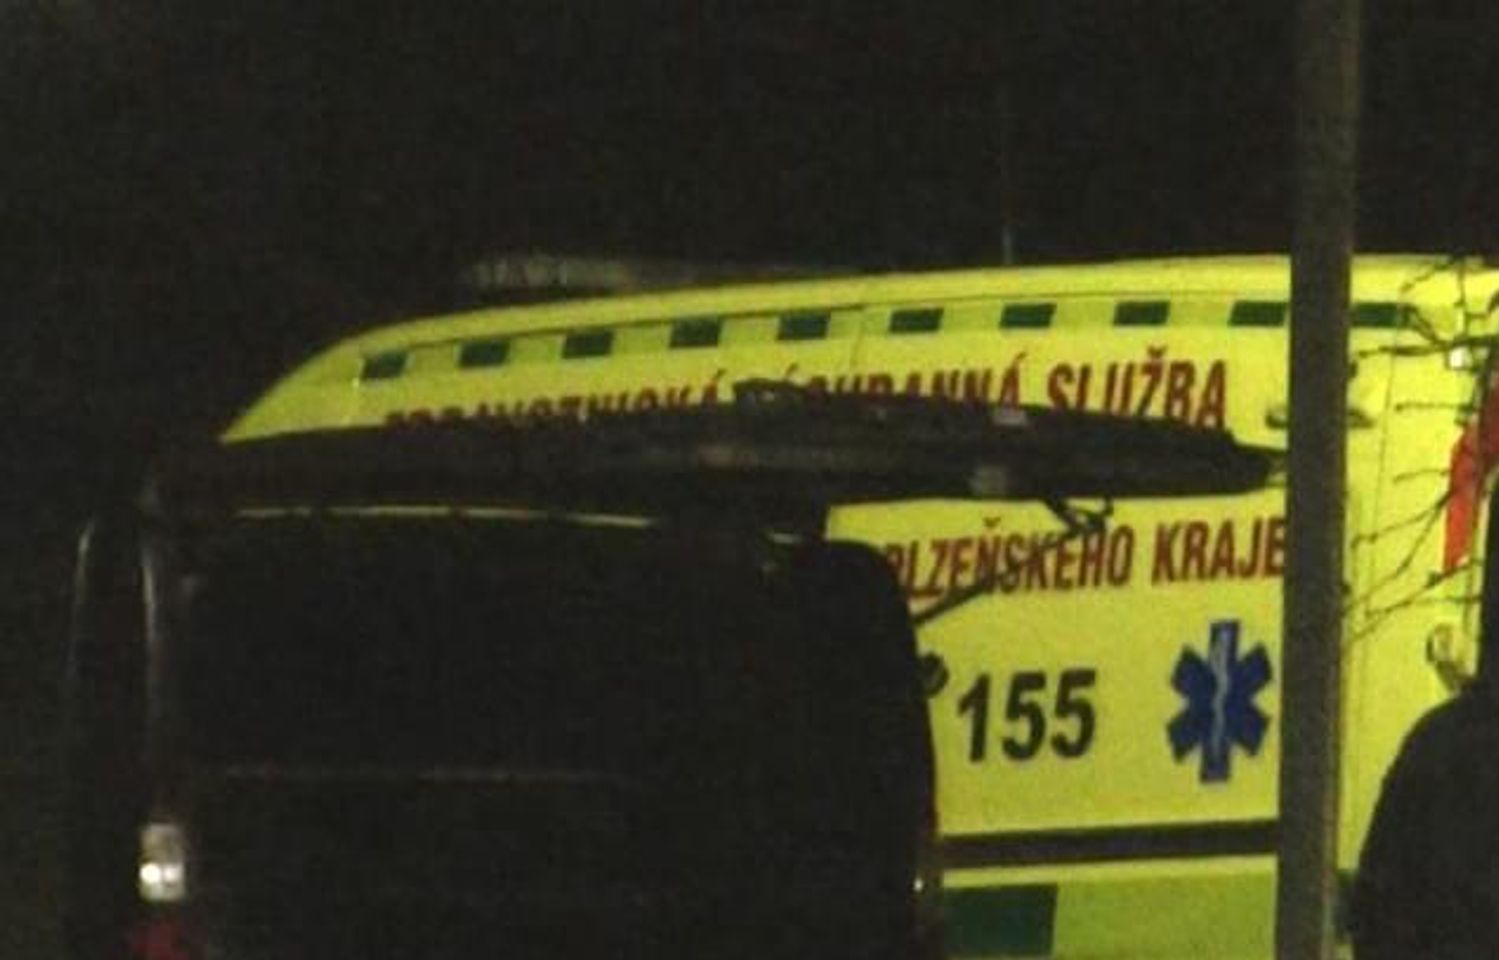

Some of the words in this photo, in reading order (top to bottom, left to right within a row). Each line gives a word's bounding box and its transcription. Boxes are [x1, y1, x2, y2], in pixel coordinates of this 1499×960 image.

[1046, 344, 1226, 429] SLUŽBA
[1151, 515, 1286, 586] KRAJE
[957, 667, 1097, 763] 155
